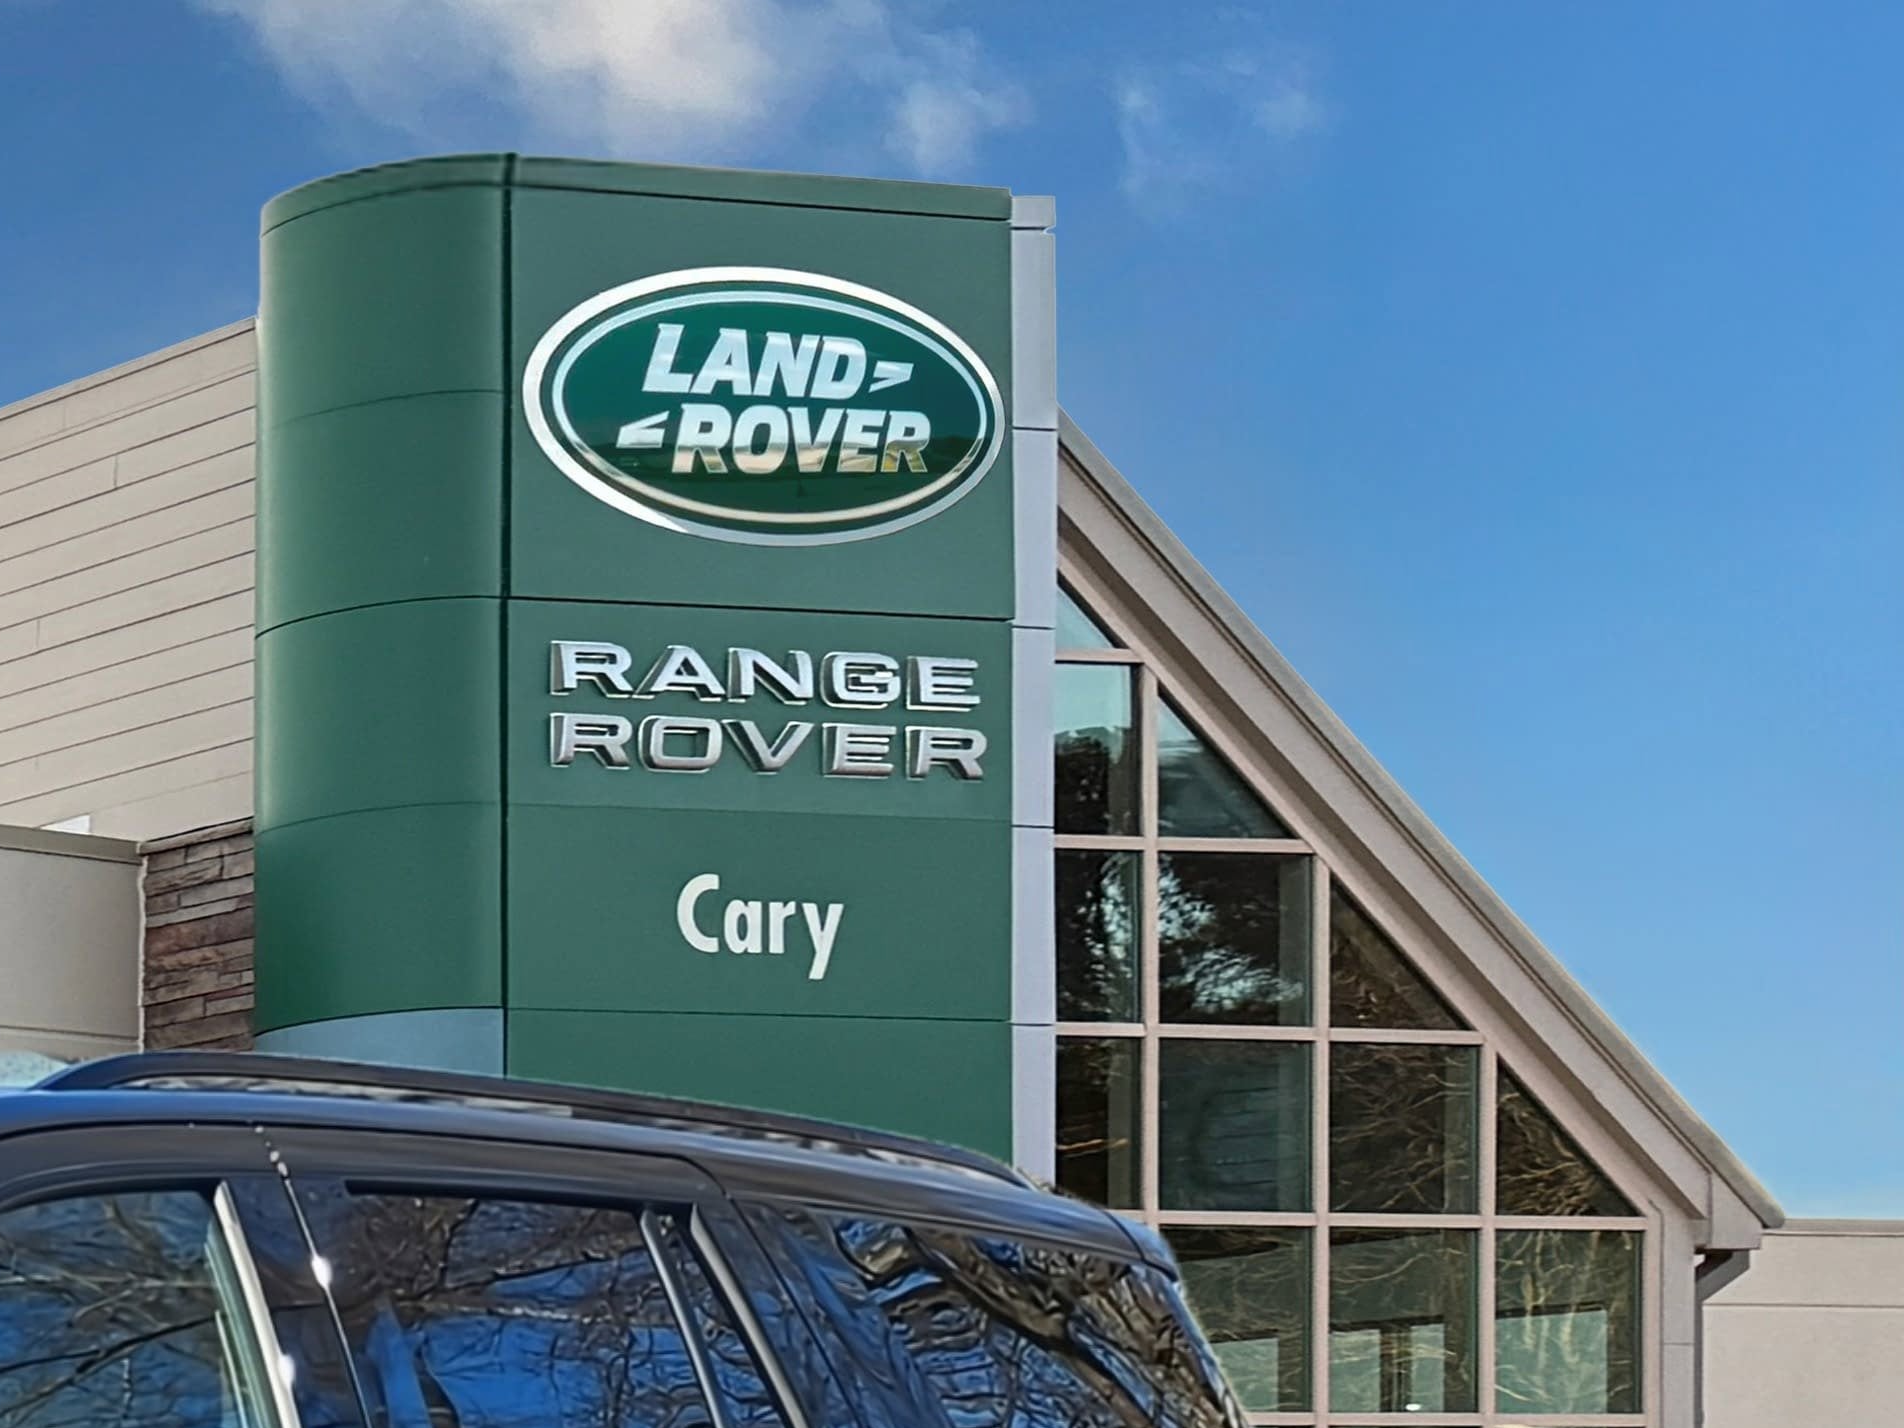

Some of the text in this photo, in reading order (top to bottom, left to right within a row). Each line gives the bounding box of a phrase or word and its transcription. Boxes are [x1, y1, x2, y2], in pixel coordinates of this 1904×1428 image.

[642, 323, 867, 399] LAND
[672, 403, 931, 474] ROVER
[550, 640, 981, 710] RANGE
[550, 712, 989, 781] ROVER
[676, 874, 845, 980] Cary
